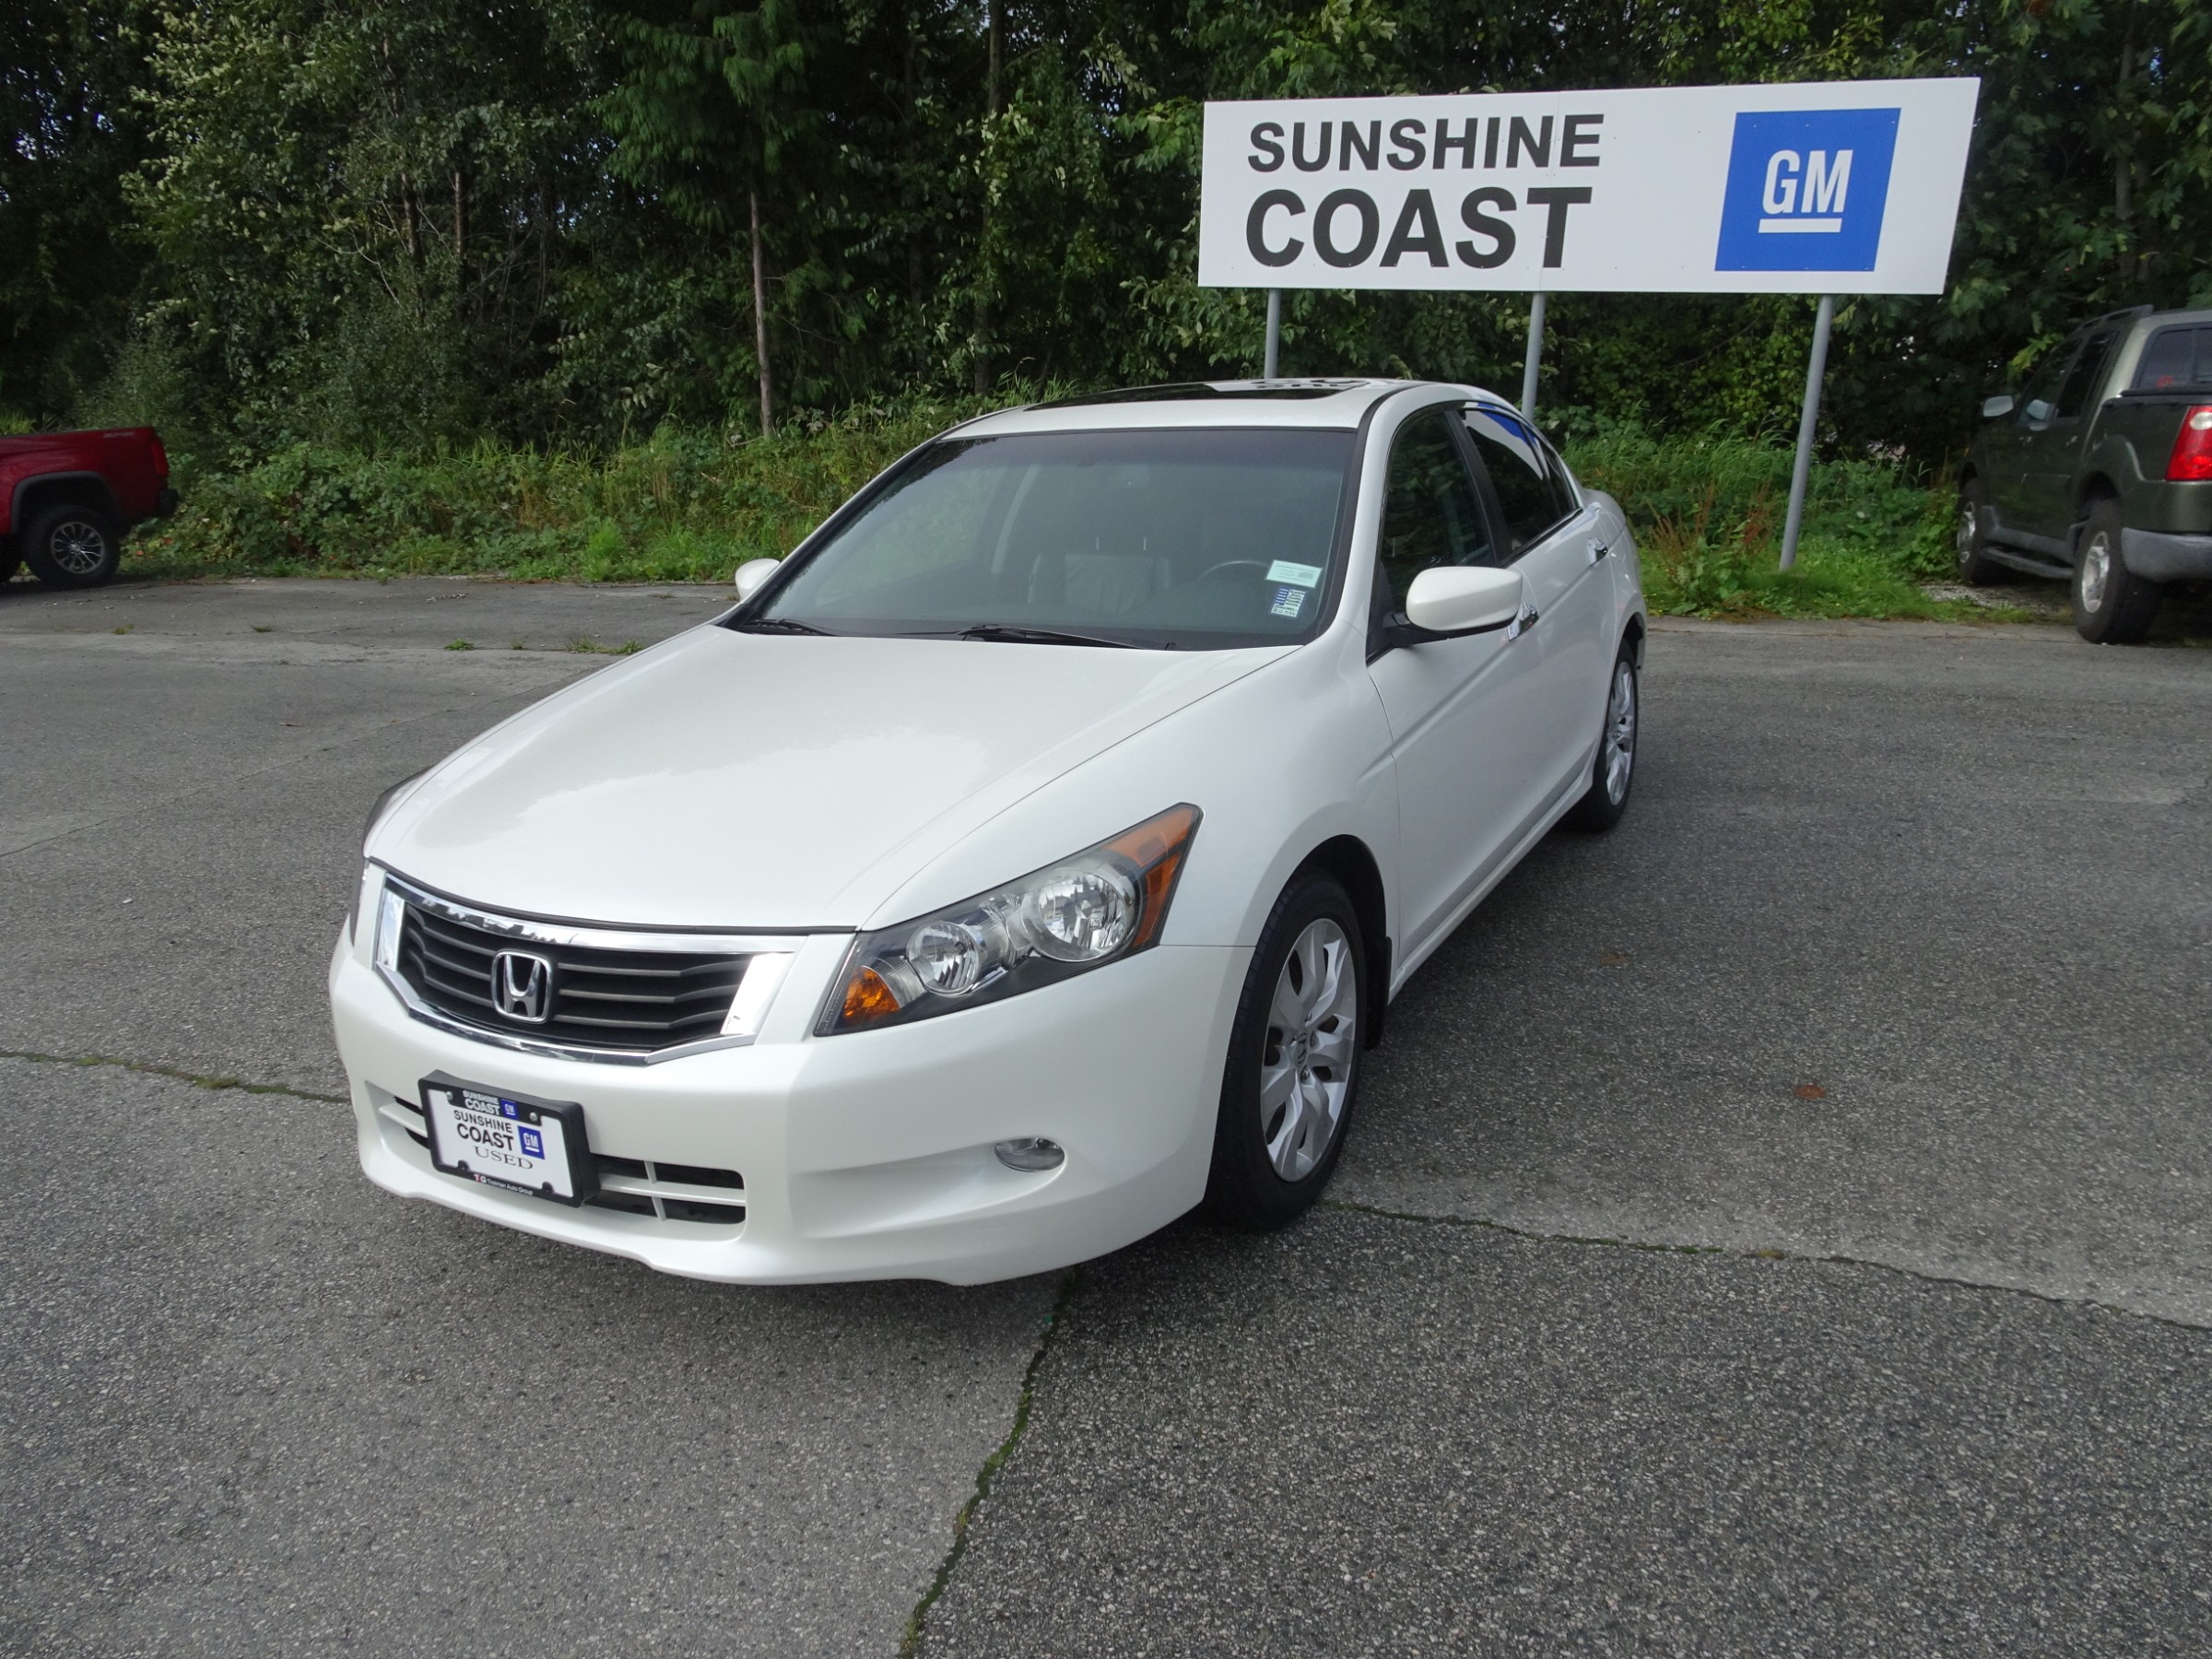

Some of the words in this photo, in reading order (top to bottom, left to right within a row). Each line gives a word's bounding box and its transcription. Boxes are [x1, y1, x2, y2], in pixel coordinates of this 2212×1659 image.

[1247, 113, 1605, 173] SUNSHINE
[1761, 149, 1853, 215] GM
[1246, 186, 1593, 269] COAST
[463, 1090, 499, 1105] SUNSHINE
[465, 1098, 500, 1116] COAST
[453, 1109, 513, 1134] SUNSHINE
[456, 1123, 514, 1152] COAST
[523, 1132, 539, 1148] GM
[473, 1146, 534, 1170] USED
